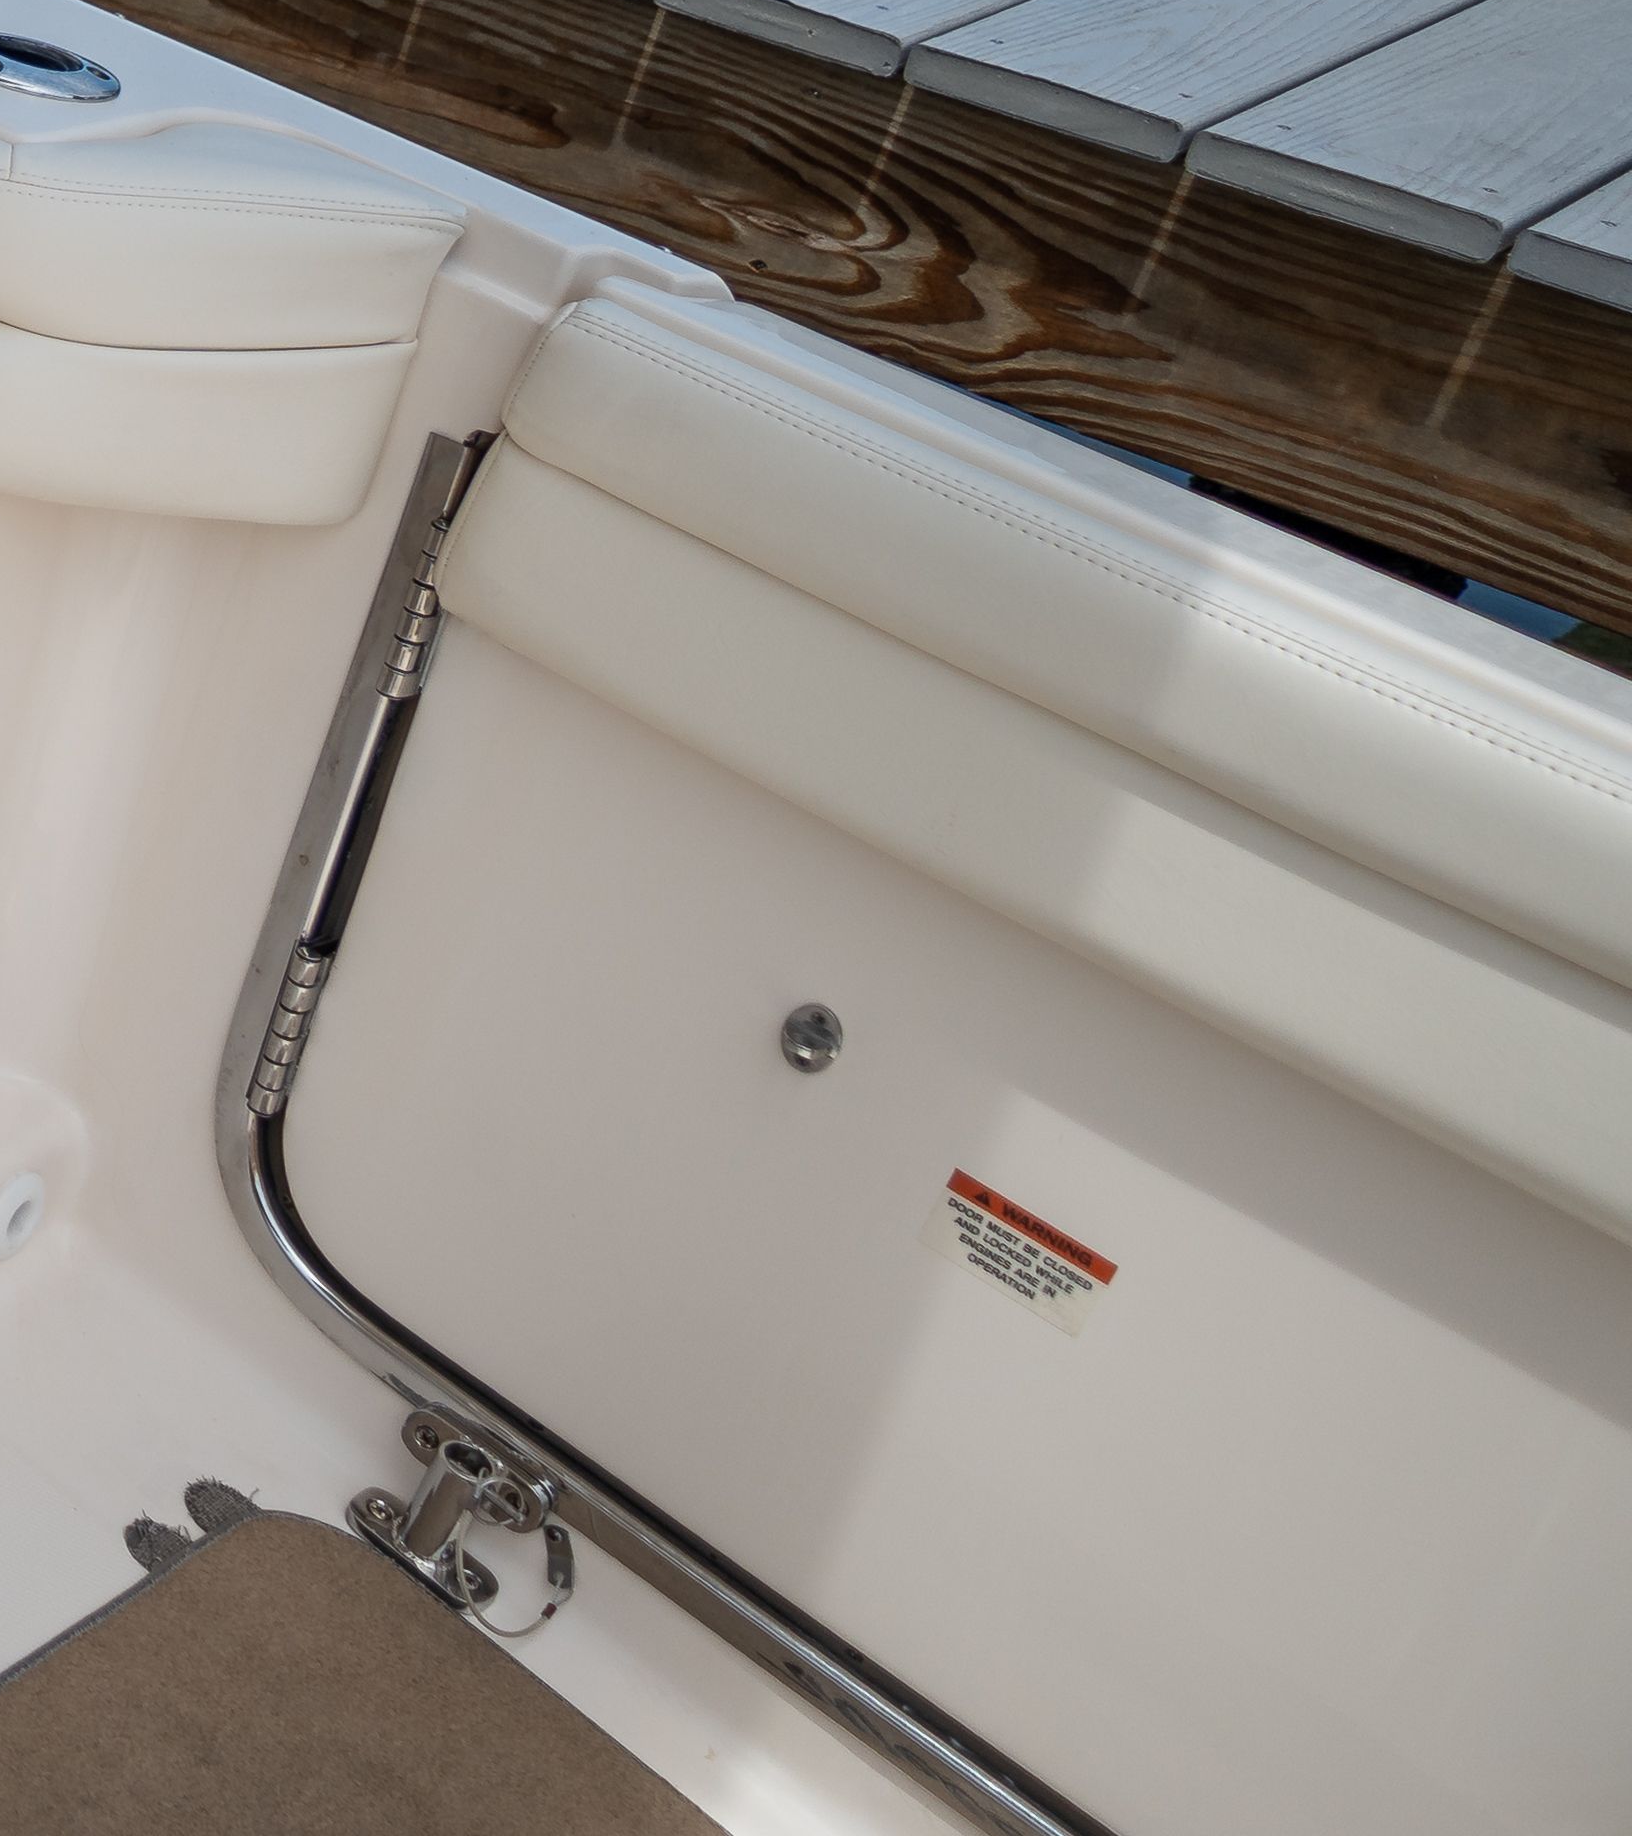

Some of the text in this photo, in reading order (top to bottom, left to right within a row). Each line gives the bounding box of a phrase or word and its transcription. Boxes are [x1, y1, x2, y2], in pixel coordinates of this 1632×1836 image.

[947, 1197, 1093, 1291] DOOR MUST BE CLOSED
[954, 1216, 1075, 1294] AND LOCKED WHILE
[958, 1233, 1056, 1298] ENGINES ARE IN
[1002, 1203, 1093, 1269] WARNING
[967, 1252, 1036, 1300] OPERATION
